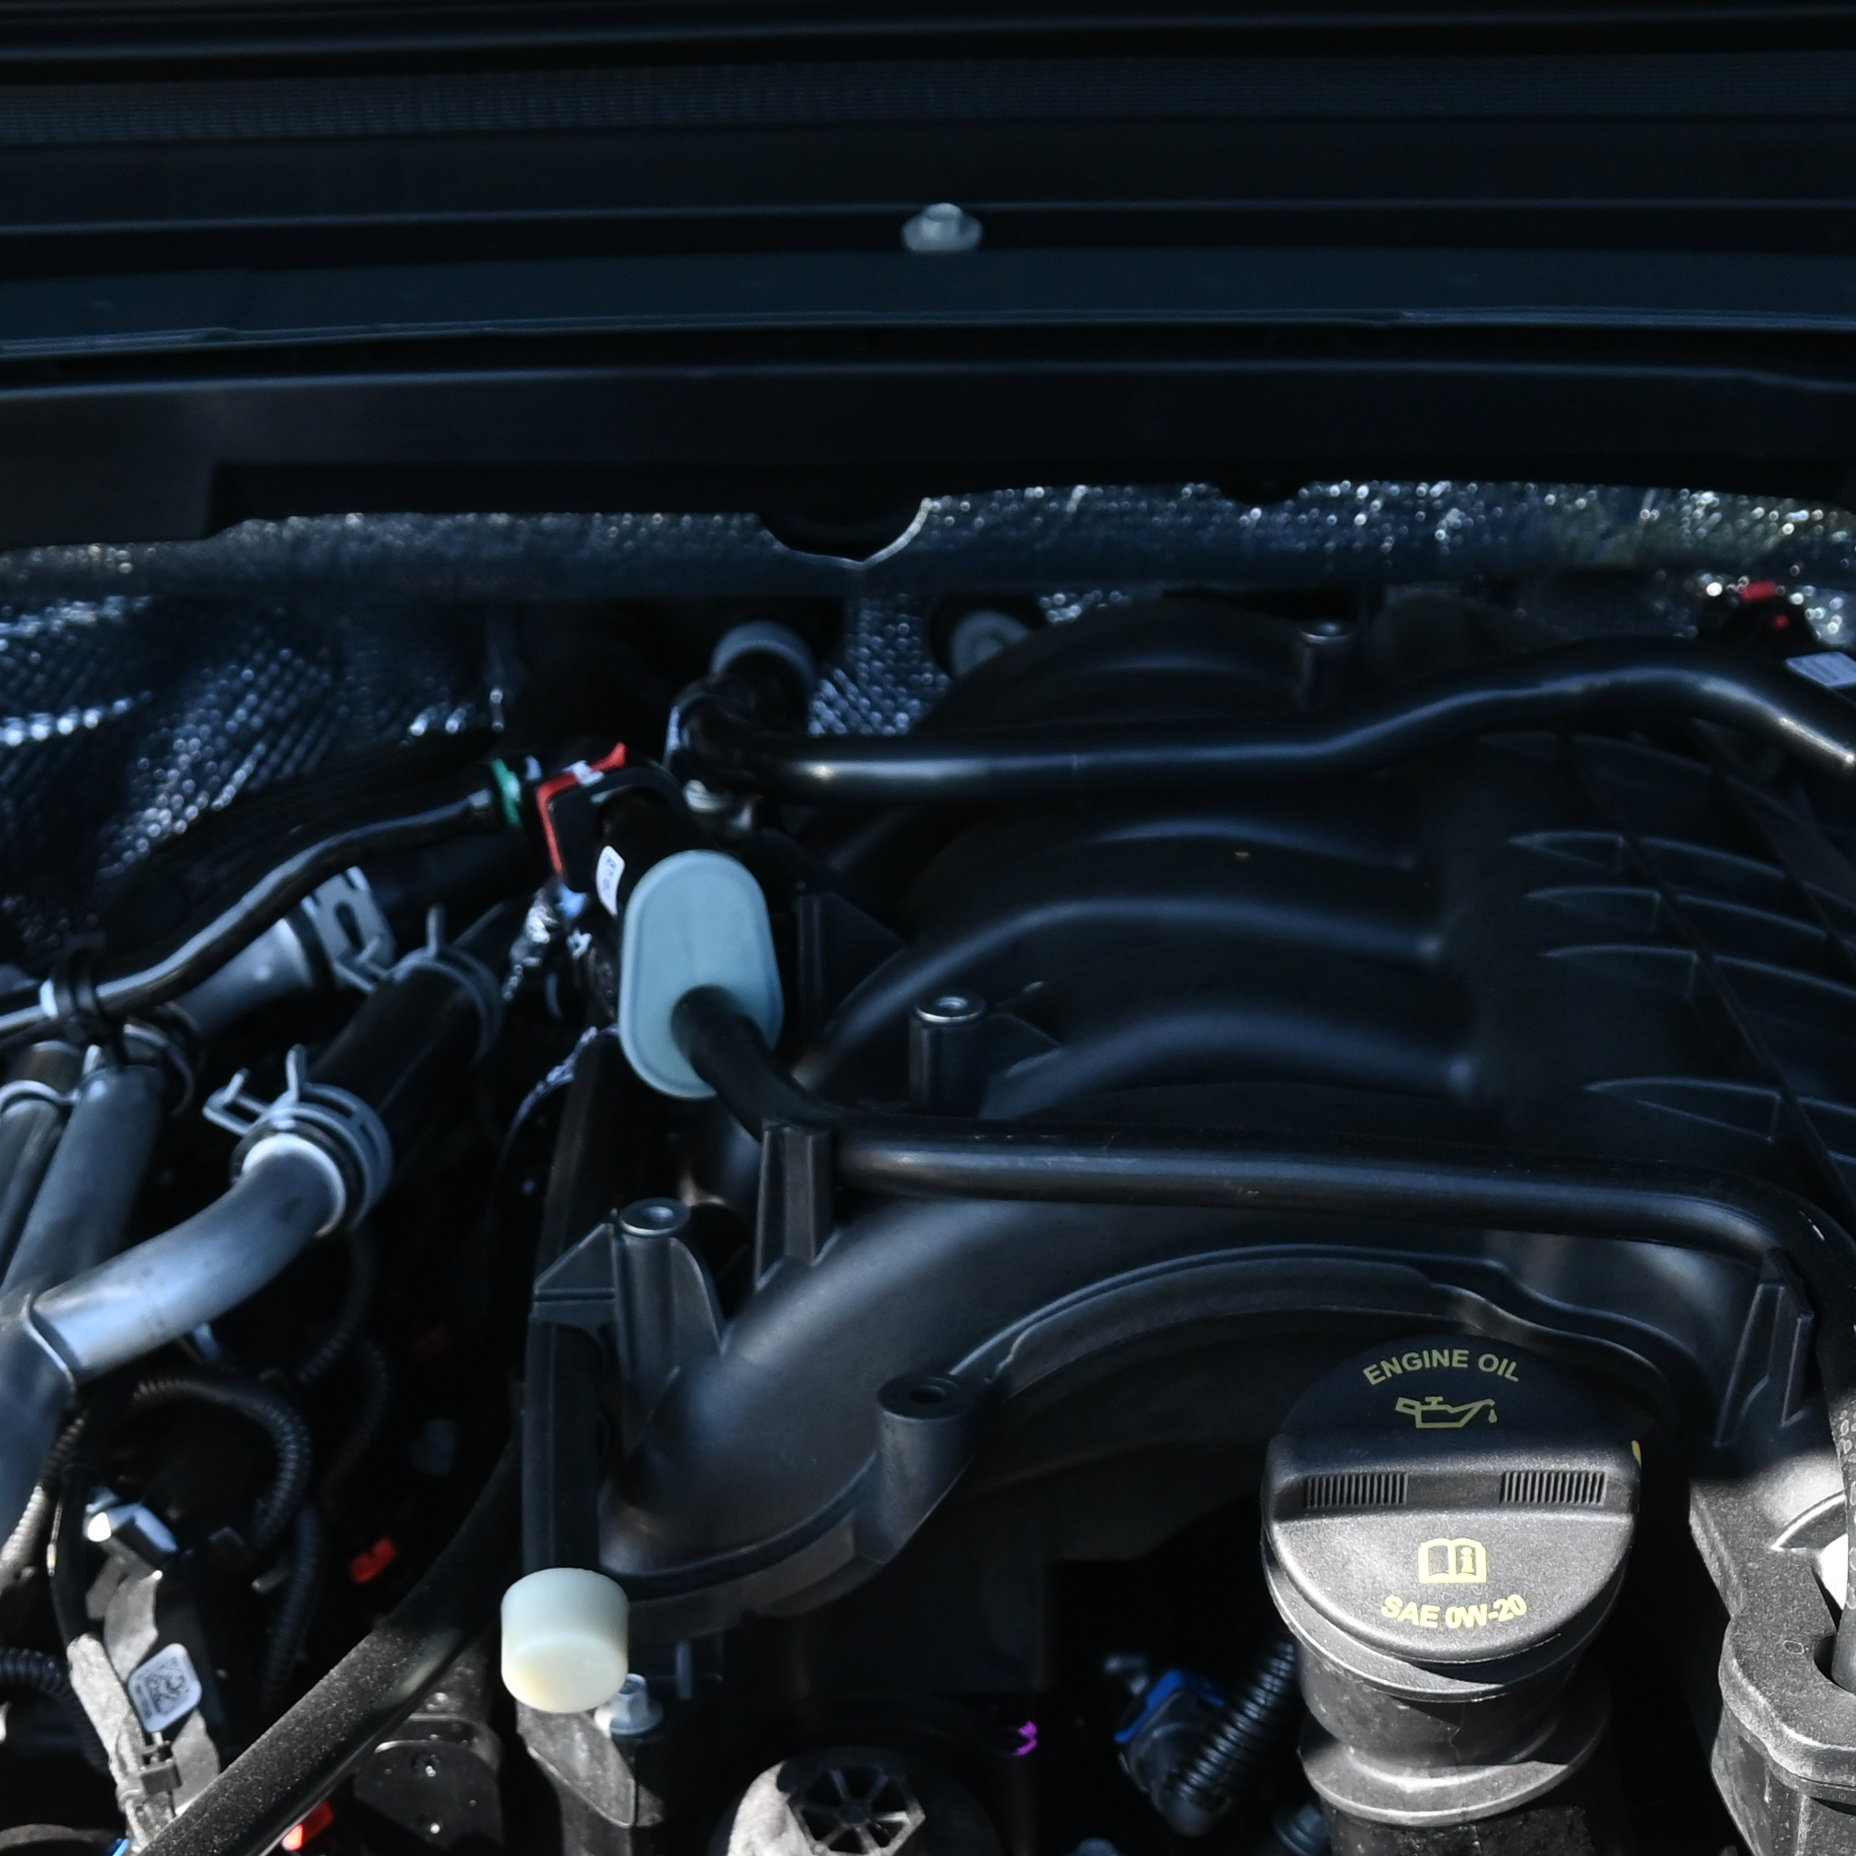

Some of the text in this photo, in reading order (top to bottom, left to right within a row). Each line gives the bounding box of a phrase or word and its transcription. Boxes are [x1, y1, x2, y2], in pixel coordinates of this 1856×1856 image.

[1363, 1349, 1521, 1386] ENGINE OIL
[1380, 1593, 1528, 1629] SAE 0W-20
